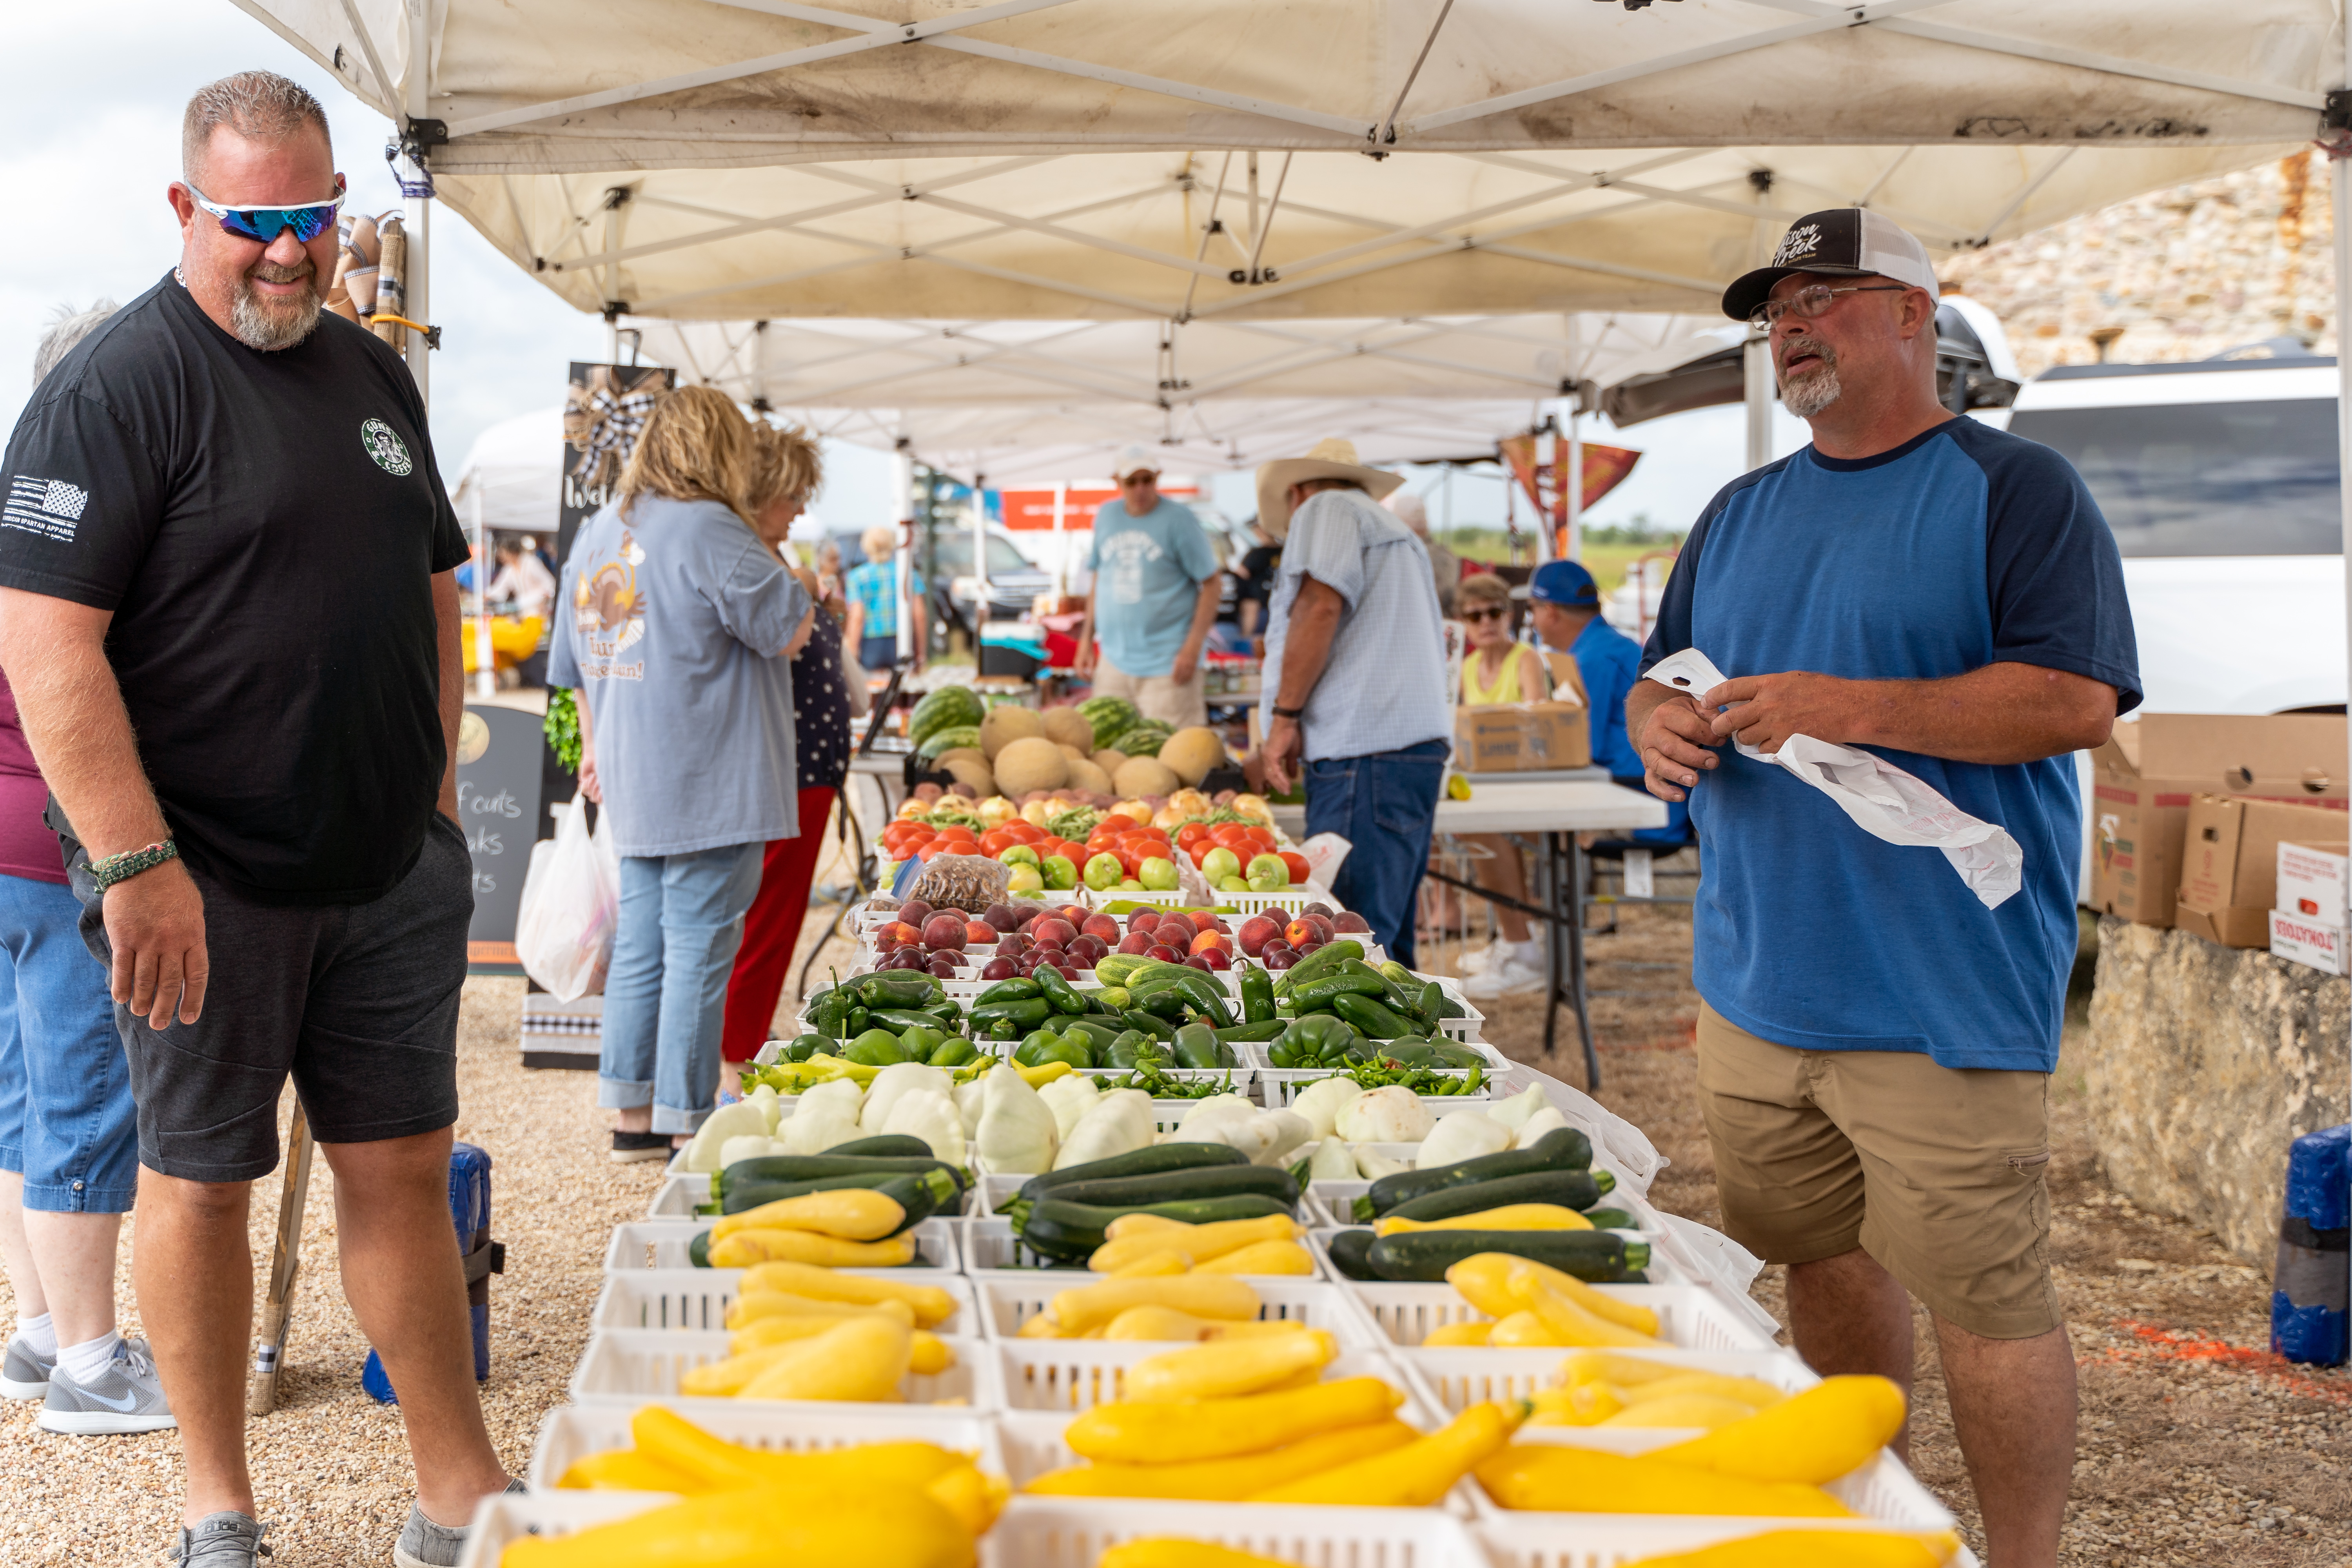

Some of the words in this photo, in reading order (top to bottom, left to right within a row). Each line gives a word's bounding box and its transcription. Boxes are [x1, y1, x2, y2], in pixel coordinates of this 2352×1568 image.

[366, 421, 391, 435] GUNS
[371, 450, 380, 460] &
[564, 475, 619, 509] Wel
[21, 518, 45, 529] SPARTAN
[46, 524, 75, 537] APPAREL
[471, 788, 521, 818] cuts
[468, 825, 504, 855] aks
[472, 868, 497, 893] ts
[205, 1520, 238, 1534] dude
